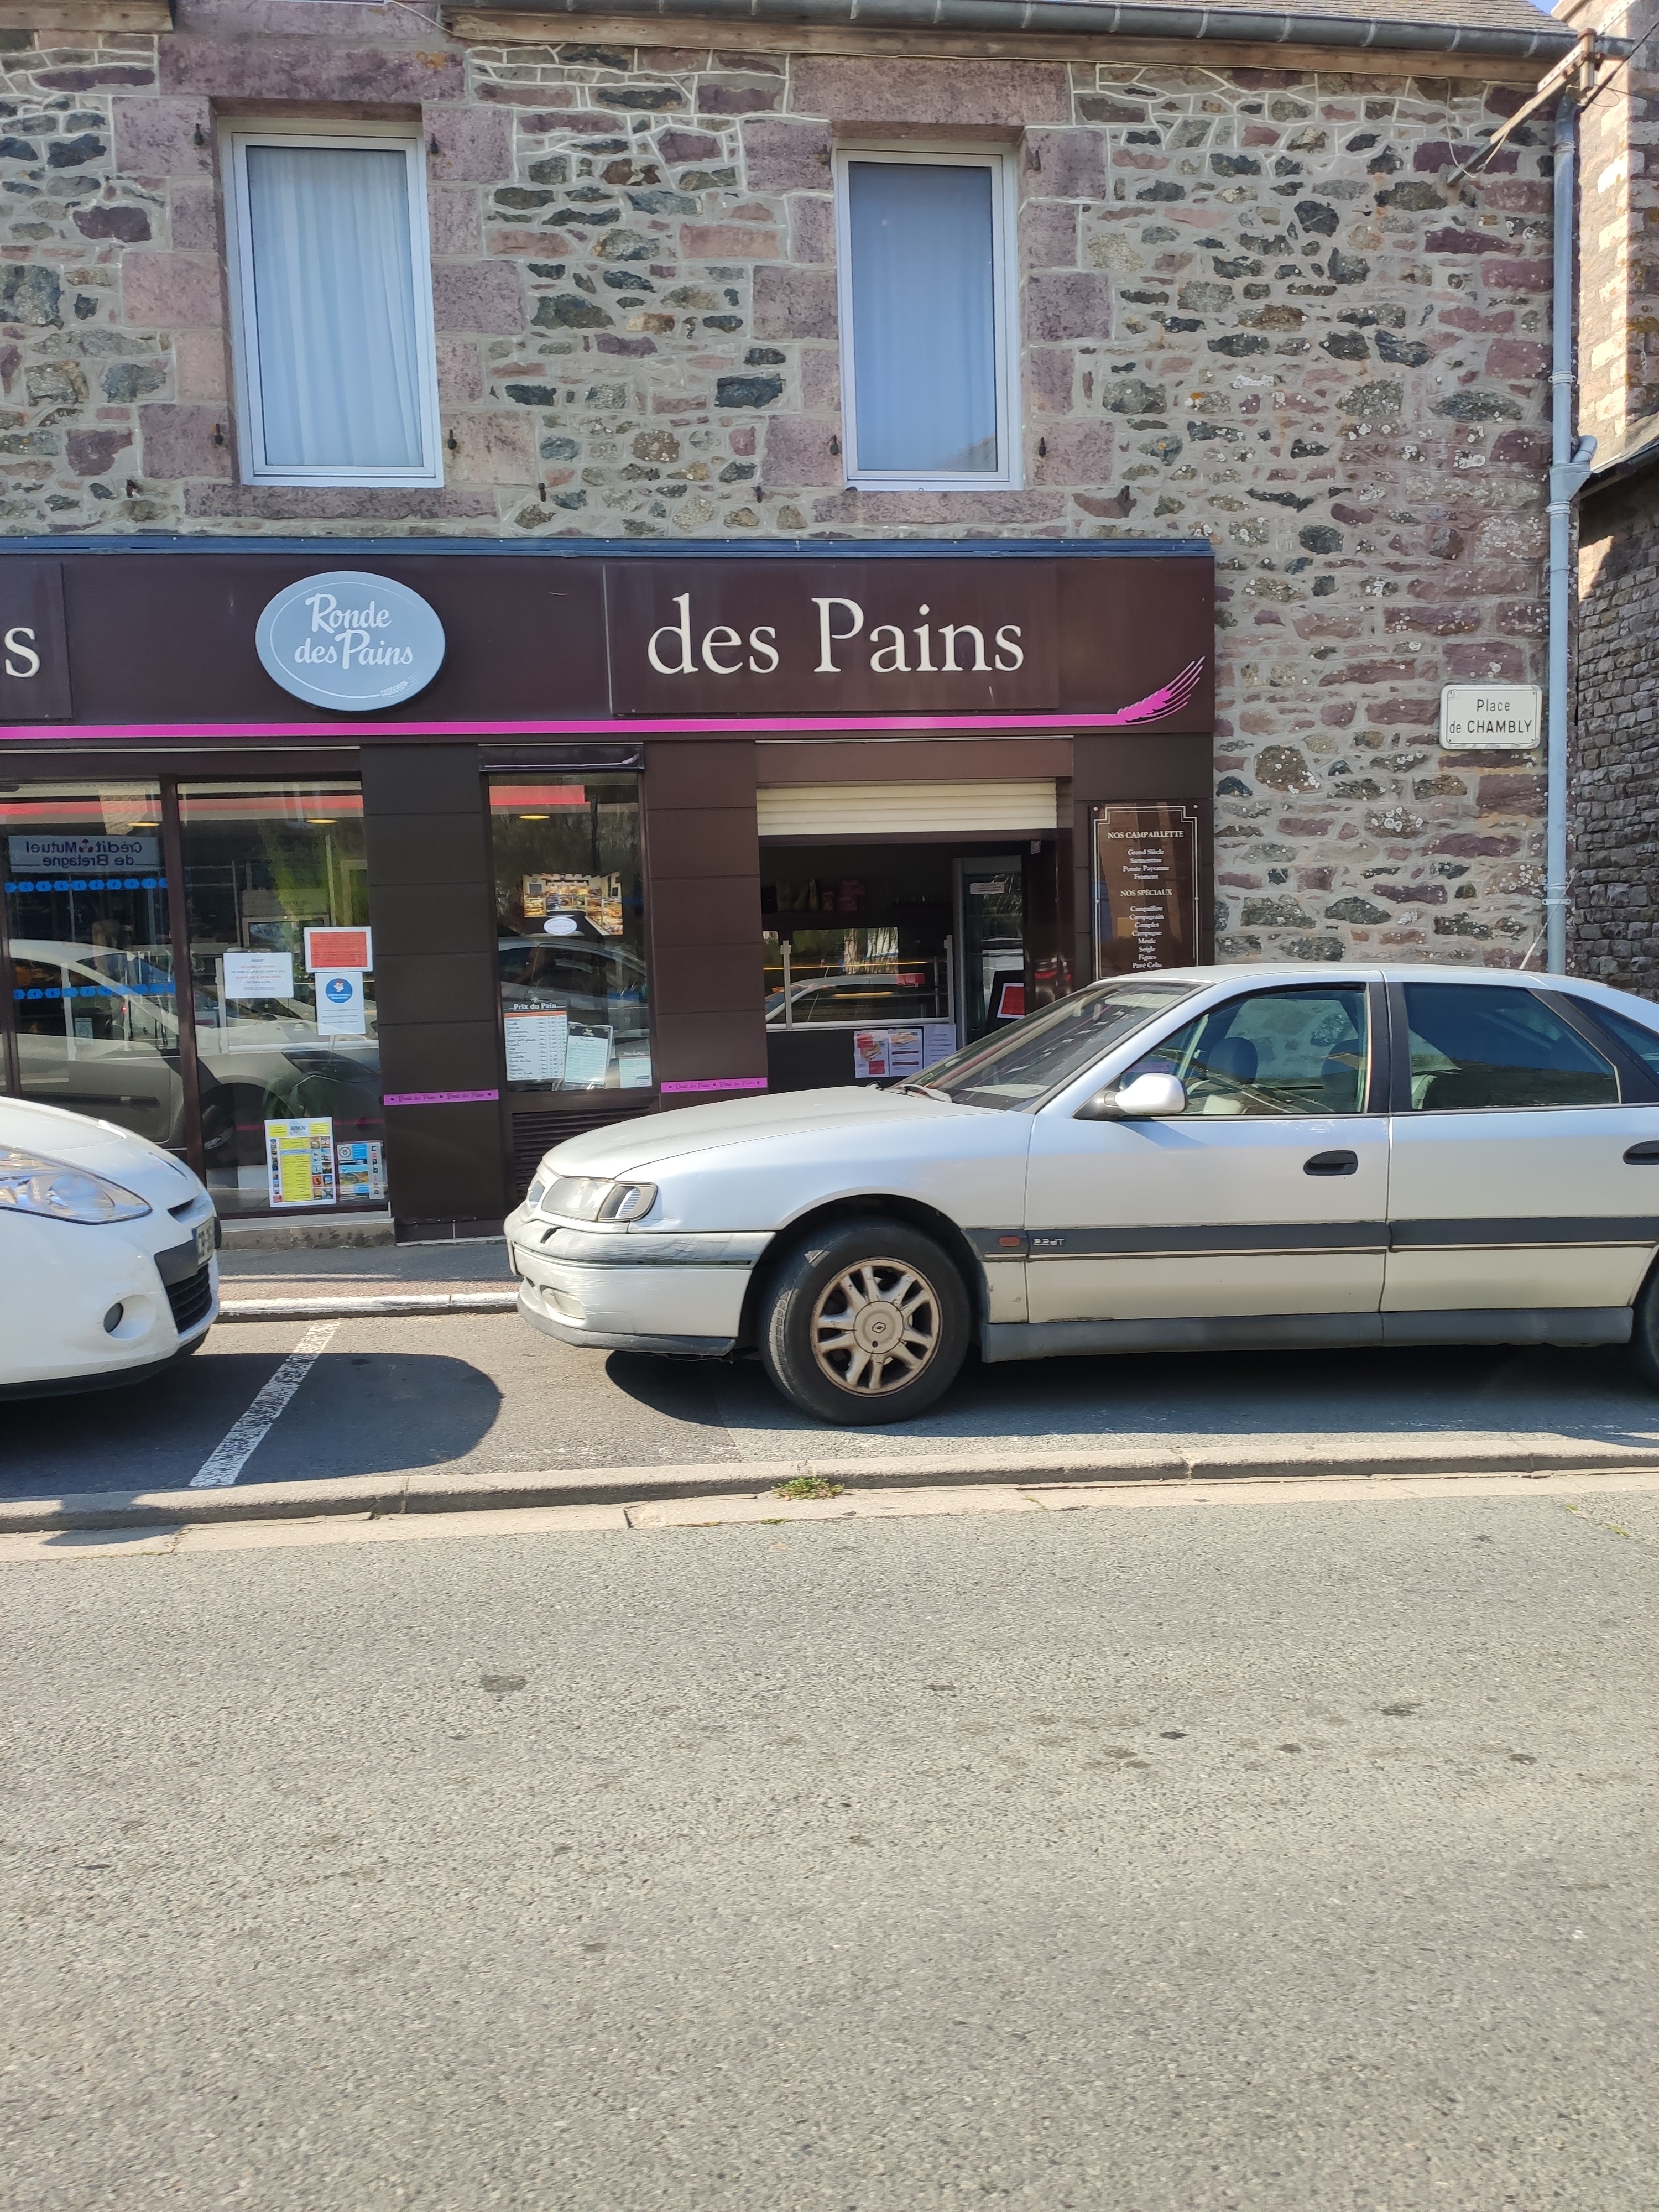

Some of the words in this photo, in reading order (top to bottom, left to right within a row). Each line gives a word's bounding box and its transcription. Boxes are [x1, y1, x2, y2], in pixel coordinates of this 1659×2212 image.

[305, 593, 392, 633] Ronde
[294, 637, 338, 664] des
[334, 629, 414, 670] Pains
[648, 592, 779, 675] des
[811, 597, 1025, 673] Pains
[1477, 698, 1511, 712] Place
[1449, 720, 1462, 734] de
[1467, 719, 1533, 733] CHAMBLY
